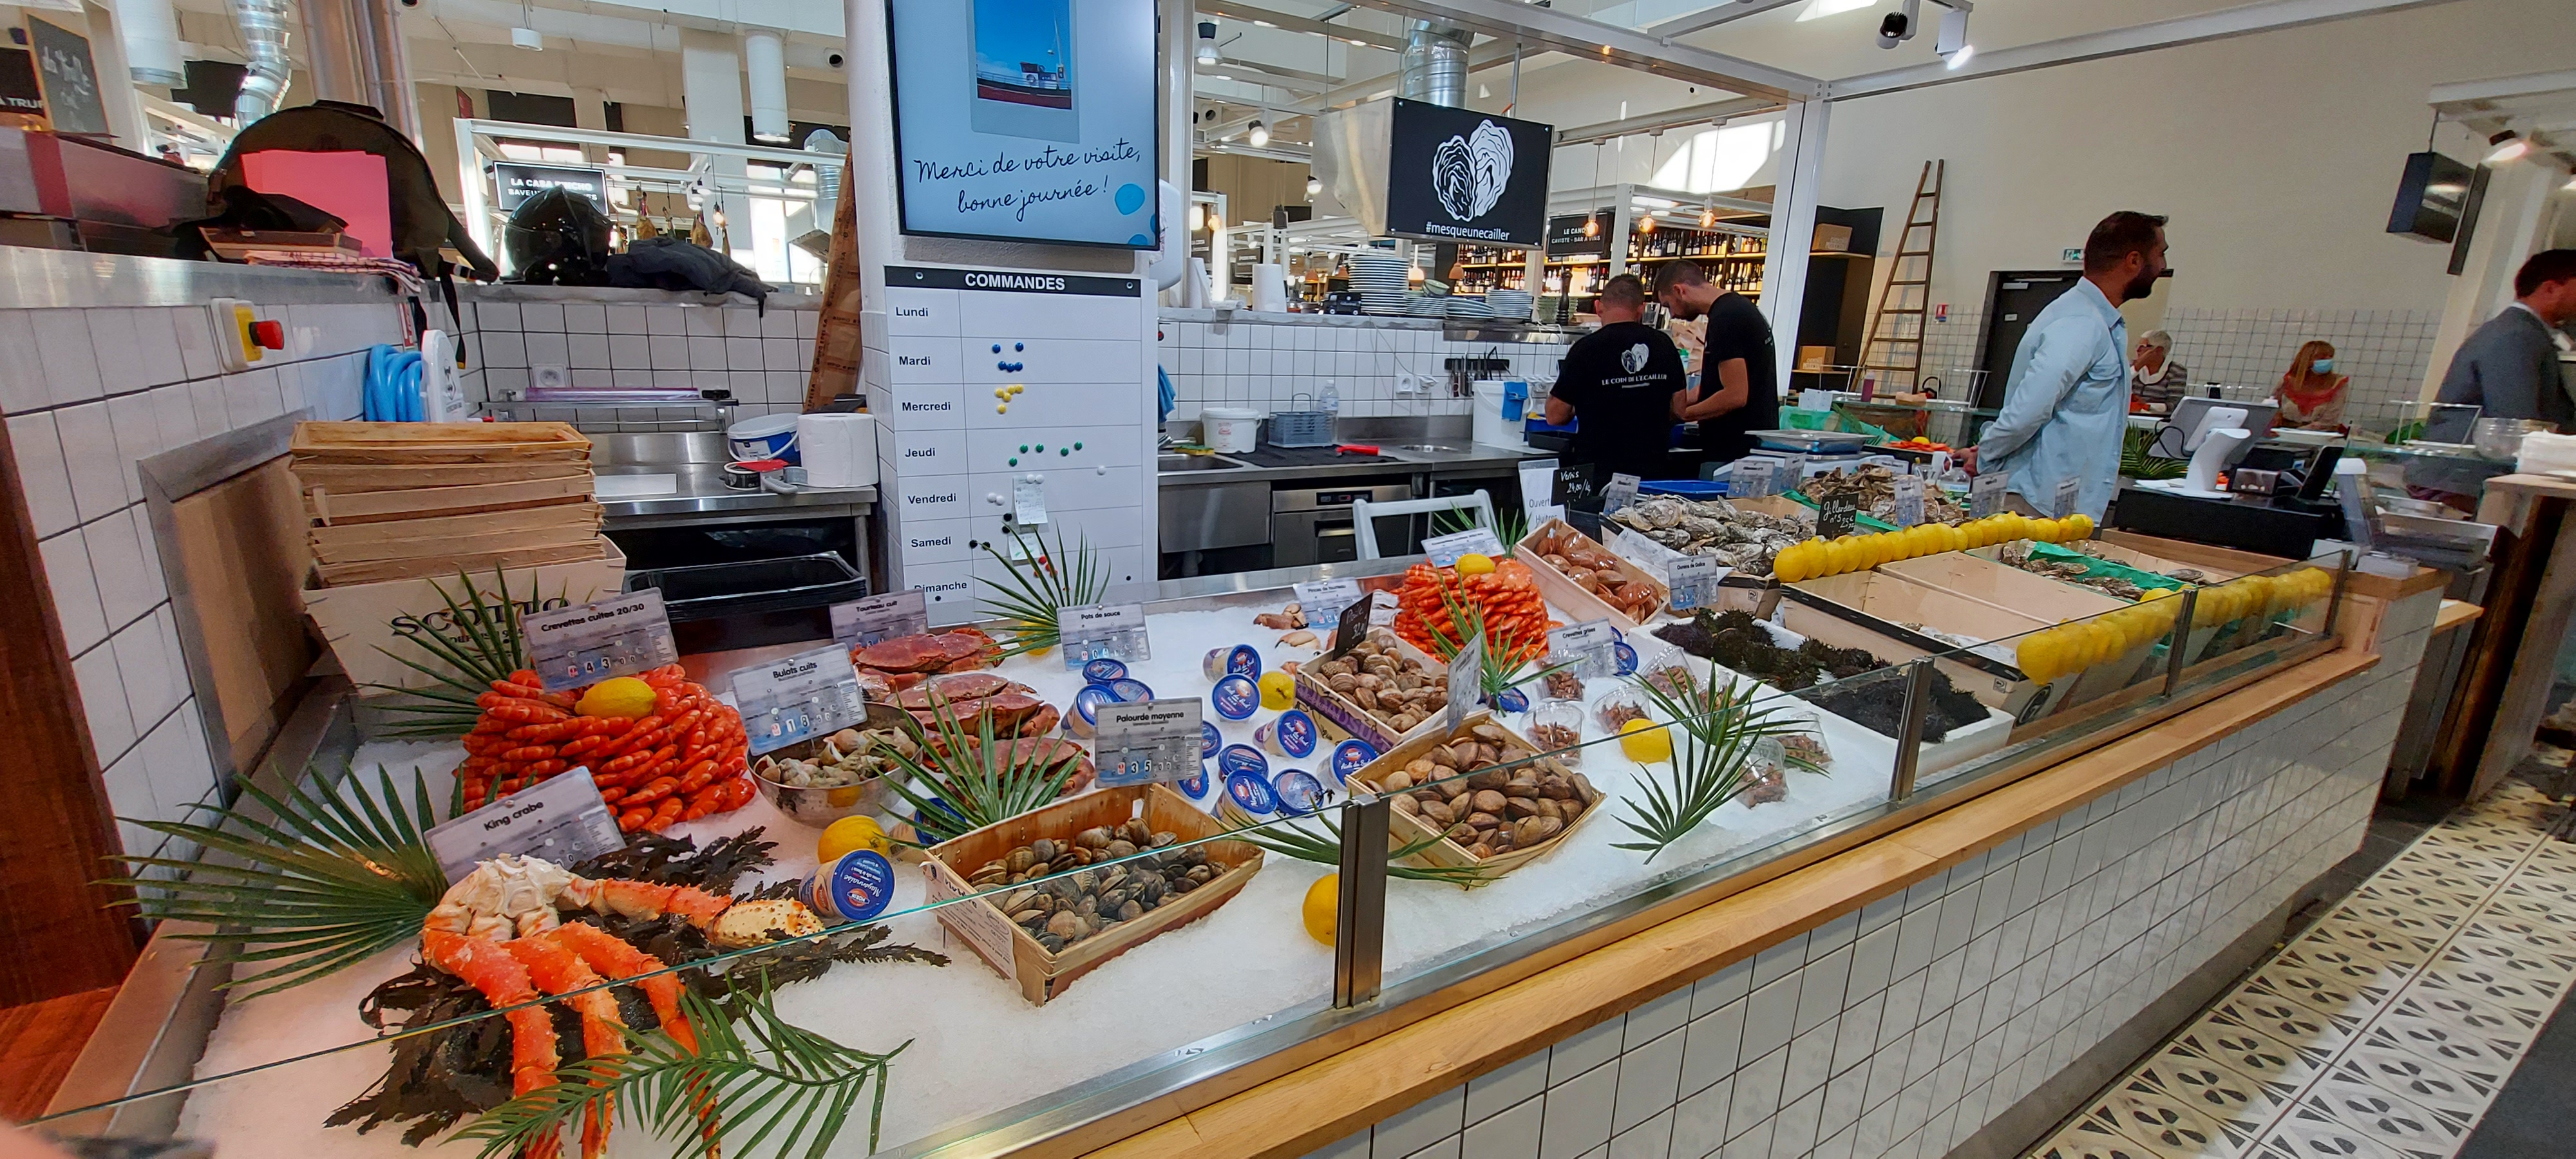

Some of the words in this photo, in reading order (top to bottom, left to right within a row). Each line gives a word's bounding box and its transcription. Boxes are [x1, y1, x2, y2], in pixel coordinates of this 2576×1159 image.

[913, 158, 989, 184] Merci
[992, 152, 1021, 174] de
[1025, 145, 1080, 171] votre
[1084, 137, 1141, 164] visite,
[511, 178, 524, 186] LA
[958, 190, 1021, 213] bonne
[1016, 180, 1099, 223] journée
[1425, 220, 1510, 242] #mesqueunecailler
[965, 273, 1065, 291] COMMANDES
[895, 306, 929, 317] Lundi
[899, 355, 931, 366] Mardi
[902, 401, 951, 412] Mercredi
[905, 448, 936, 458] Jeudi
[907, 493, 957, 505] Vendredi
[911, 536, 952, 548] Samedi
[857, 603, 885, 612] Tourteau
[541, 617, 585, 632] Crevettes
[587, 610, 615, 621] cuites
[616, 603, 645, 616] 20/30
[1562, 630, 1582, 639] Crevettes
[1584, 627, 1596, 636] grises
[773, 667, 798, 679] Bulots
[799, 662, 818, 672] cuits
[1116, 713, 1150, 723] Palourde
[1151, 711, 1184, 721] moyenne
[484, 815, 511, 831] King
[513, 801, 544, 820] crabe
[843, 874, 883, 898] Mayonnaise
